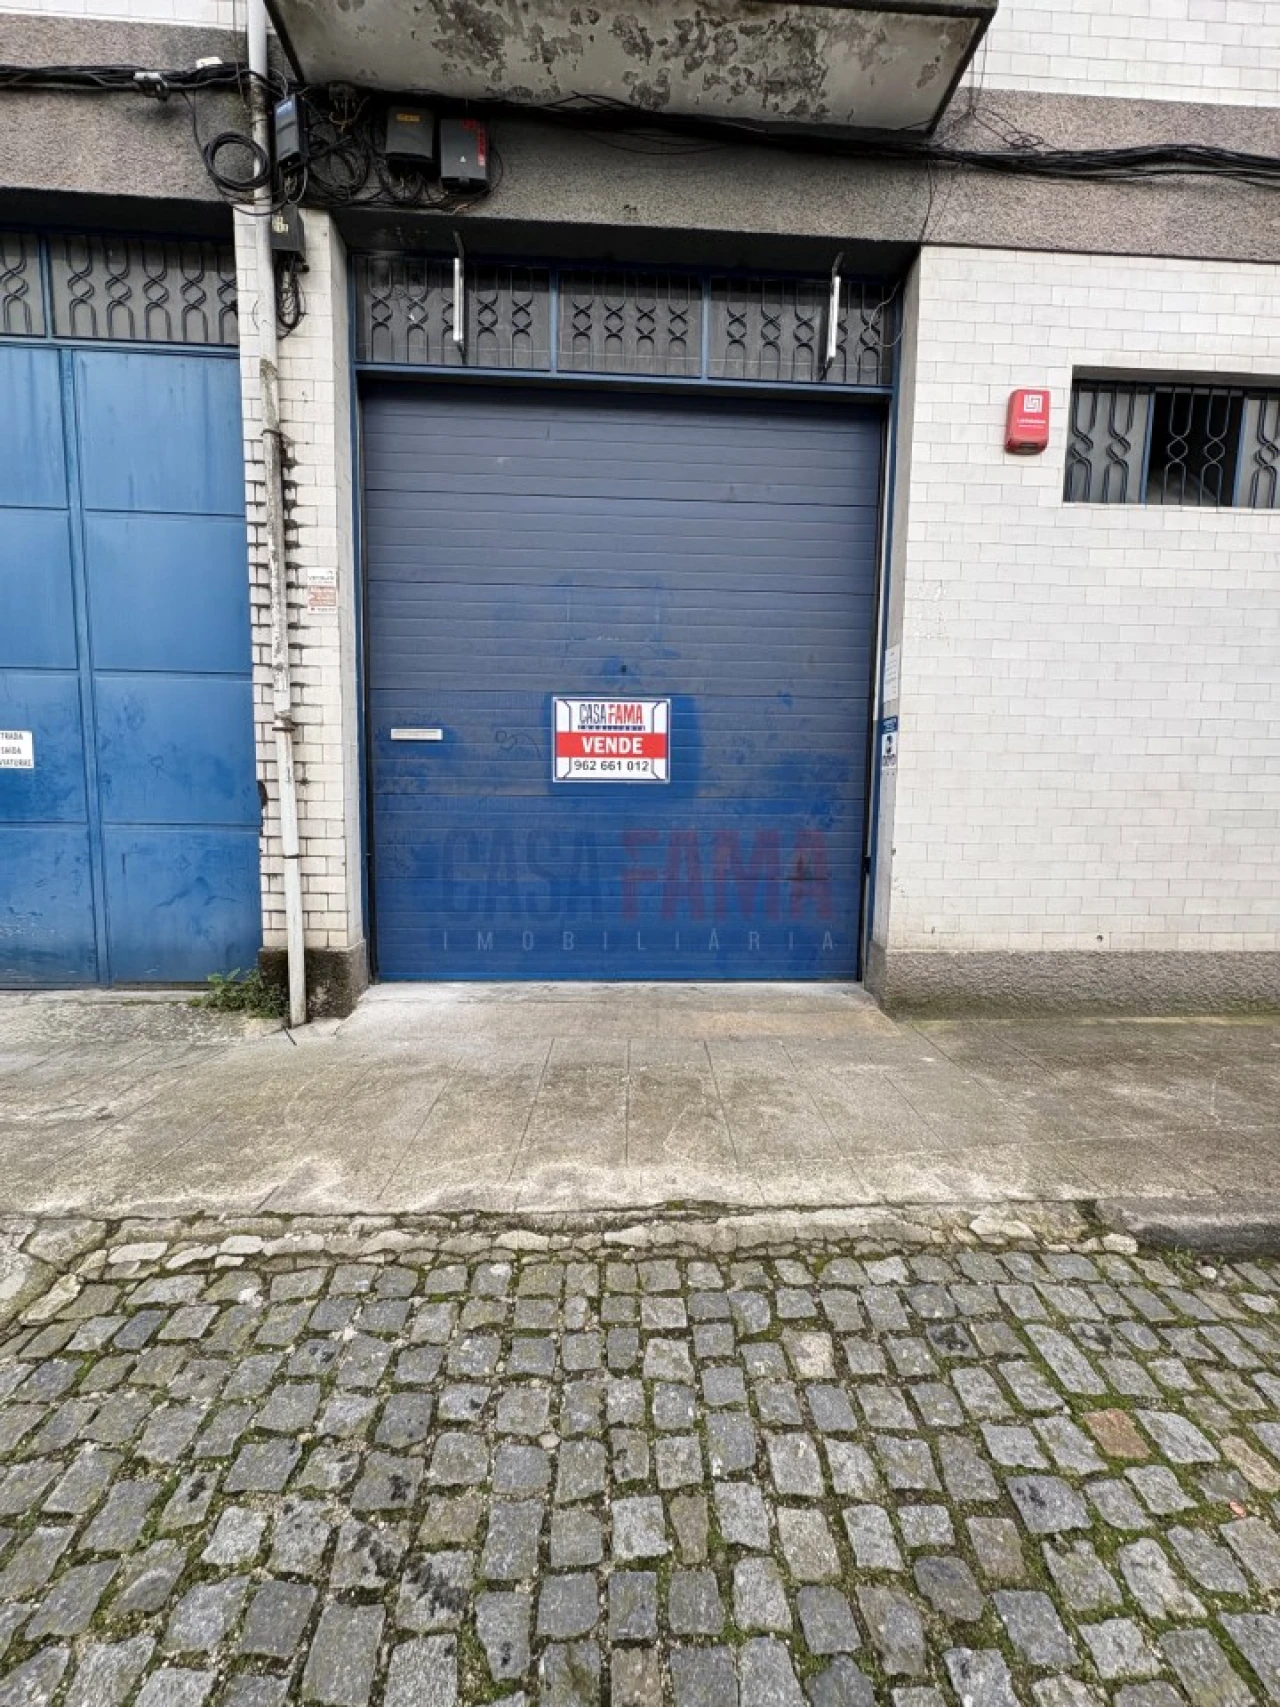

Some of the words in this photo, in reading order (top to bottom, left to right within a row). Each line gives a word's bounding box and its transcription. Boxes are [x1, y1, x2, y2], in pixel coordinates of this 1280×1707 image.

[582, 736, 644, 755] VENDE
[574, 761, 596, 771] 962
[600, 761, 622, 771] 661
[627, 761, 649, 772] 012
